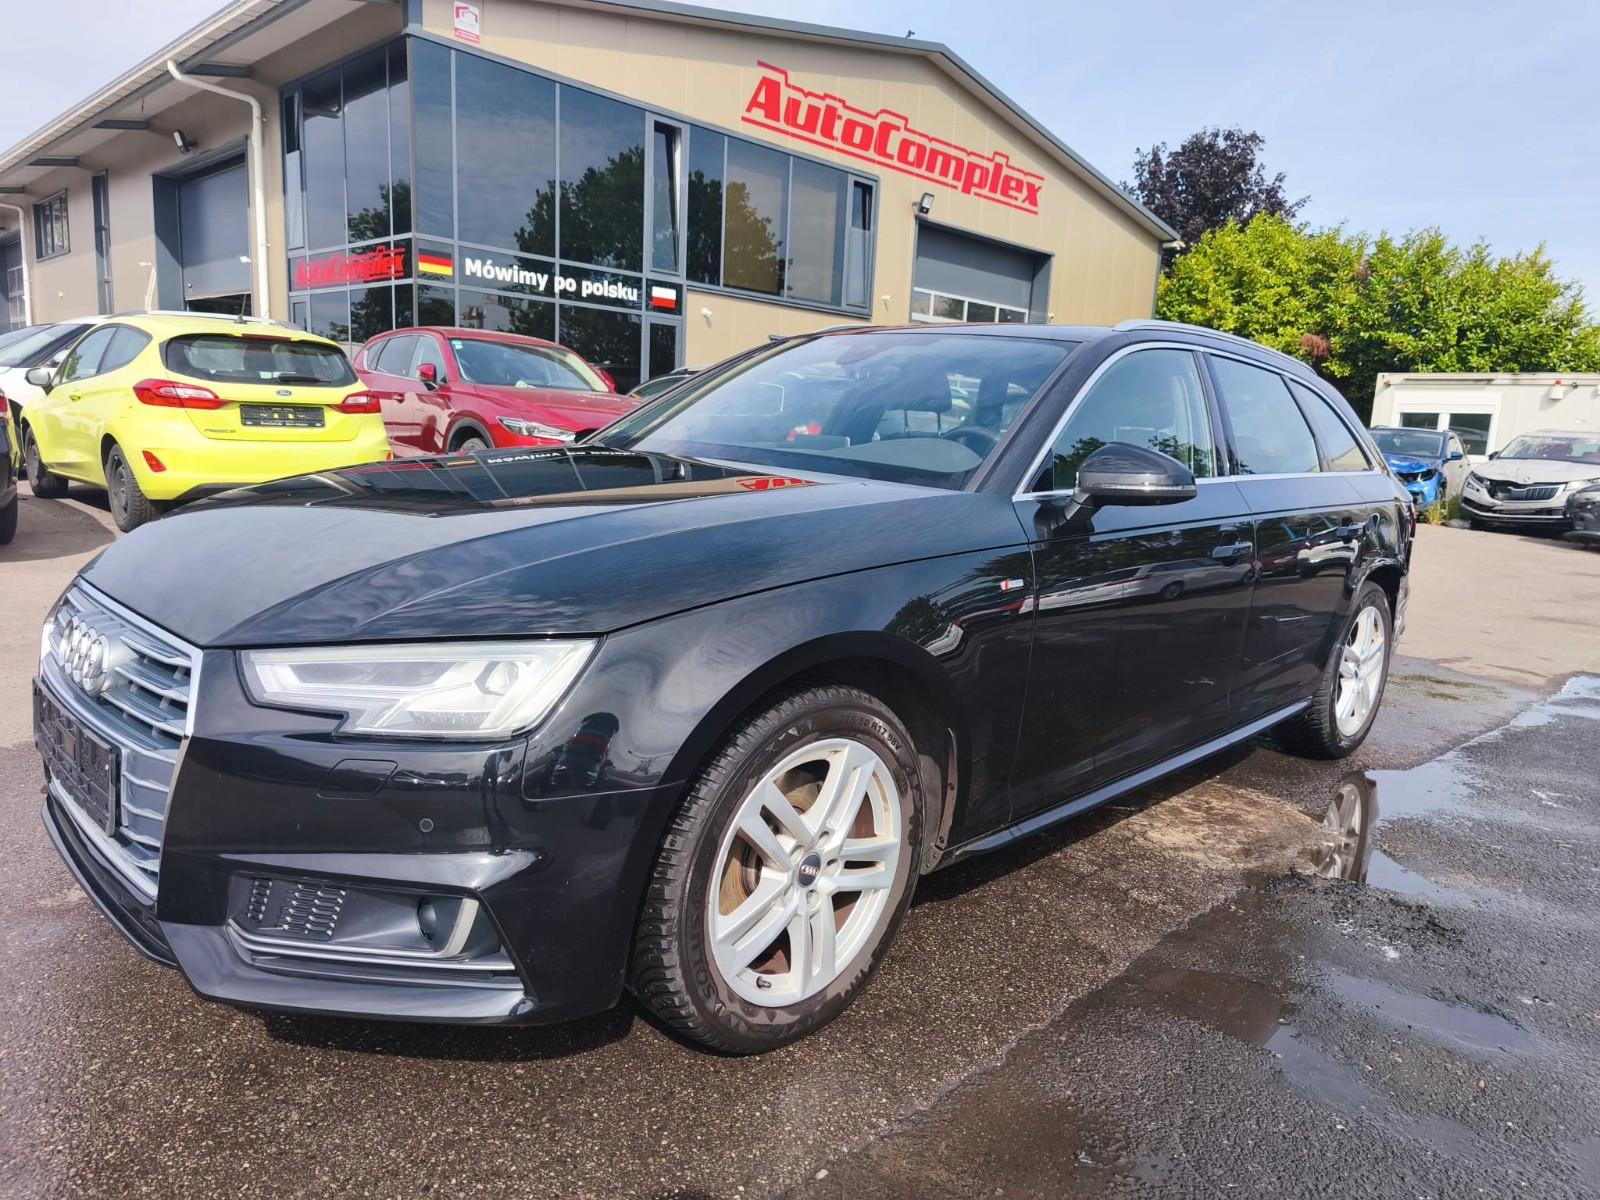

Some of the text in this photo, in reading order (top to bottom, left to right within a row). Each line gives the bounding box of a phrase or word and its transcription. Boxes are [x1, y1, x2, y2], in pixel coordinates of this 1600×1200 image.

[745, 76, 1042, 208] AutoComplex
[465, 257, 638, 302] Mówimy po polsku
[871, 721, 888, 736] R17
